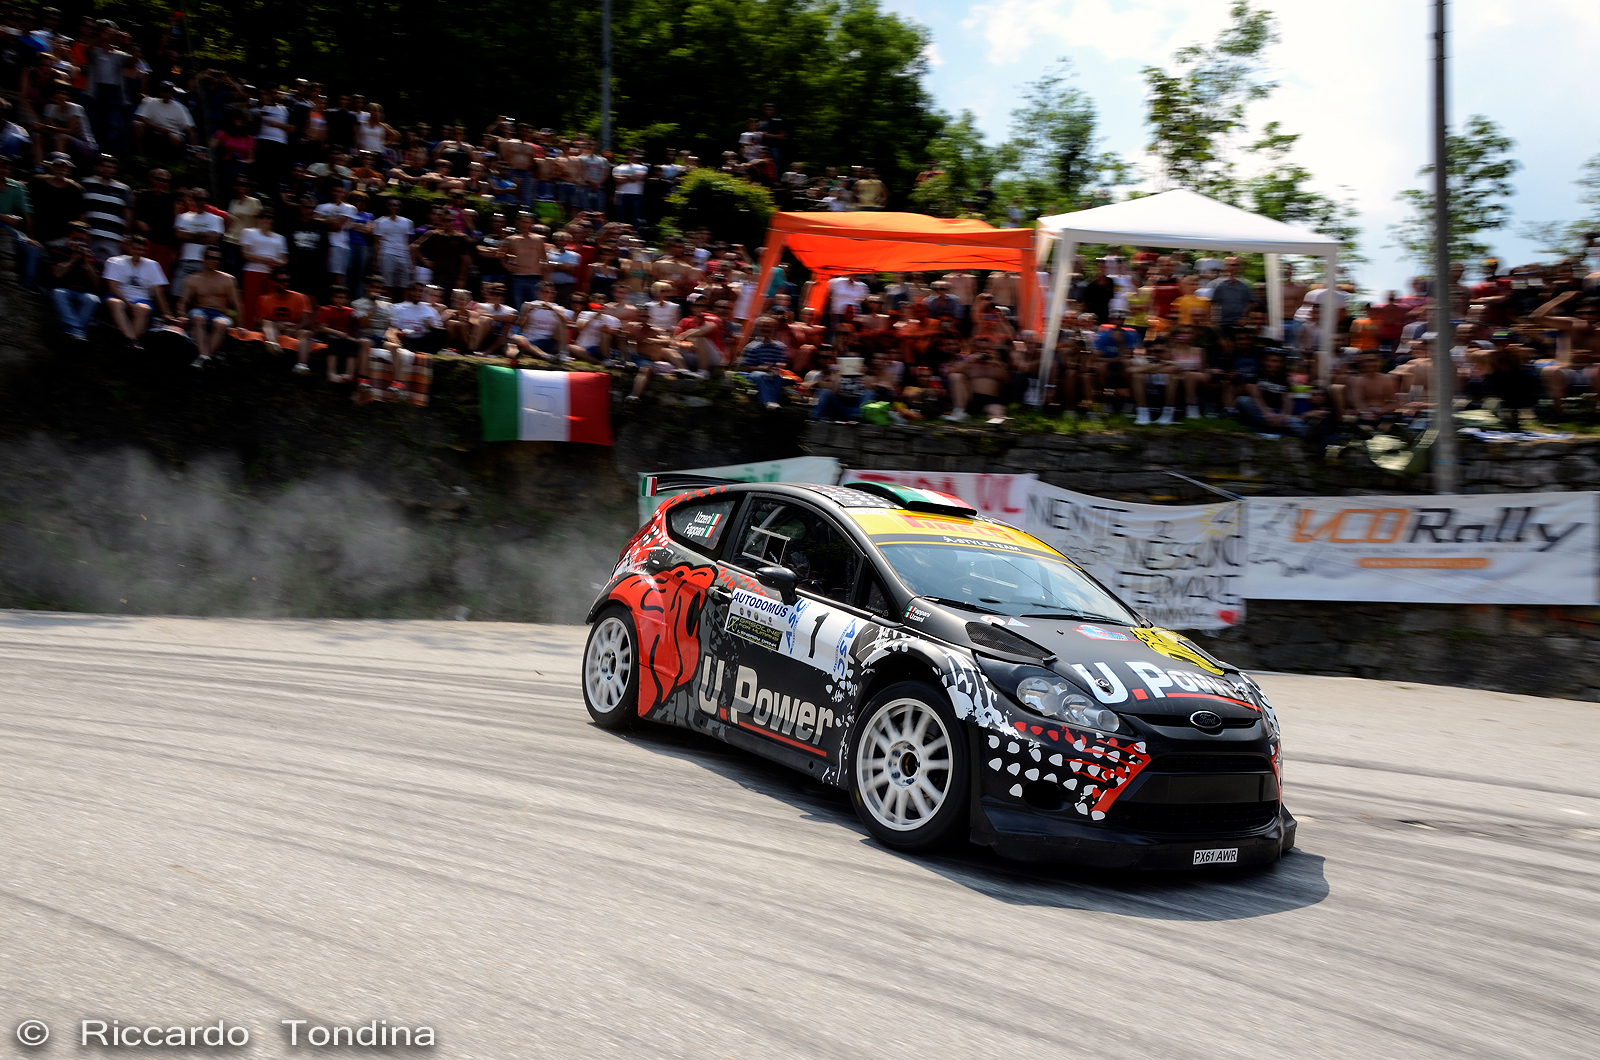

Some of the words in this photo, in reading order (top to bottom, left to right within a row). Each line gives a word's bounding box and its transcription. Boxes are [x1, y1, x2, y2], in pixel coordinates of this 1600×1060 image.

[992, 542, 1021, 552] TEAM
[733, 591, 789, 618] AUTODOMUS
[808, 612, 831, 659] 1
[698, 655, 834, 745] U.Power
[1199, 713, 1218, 726] Ford
[1195, 851, 1215, 863] PX61
[1216, 850, 1237, 862] AWR
